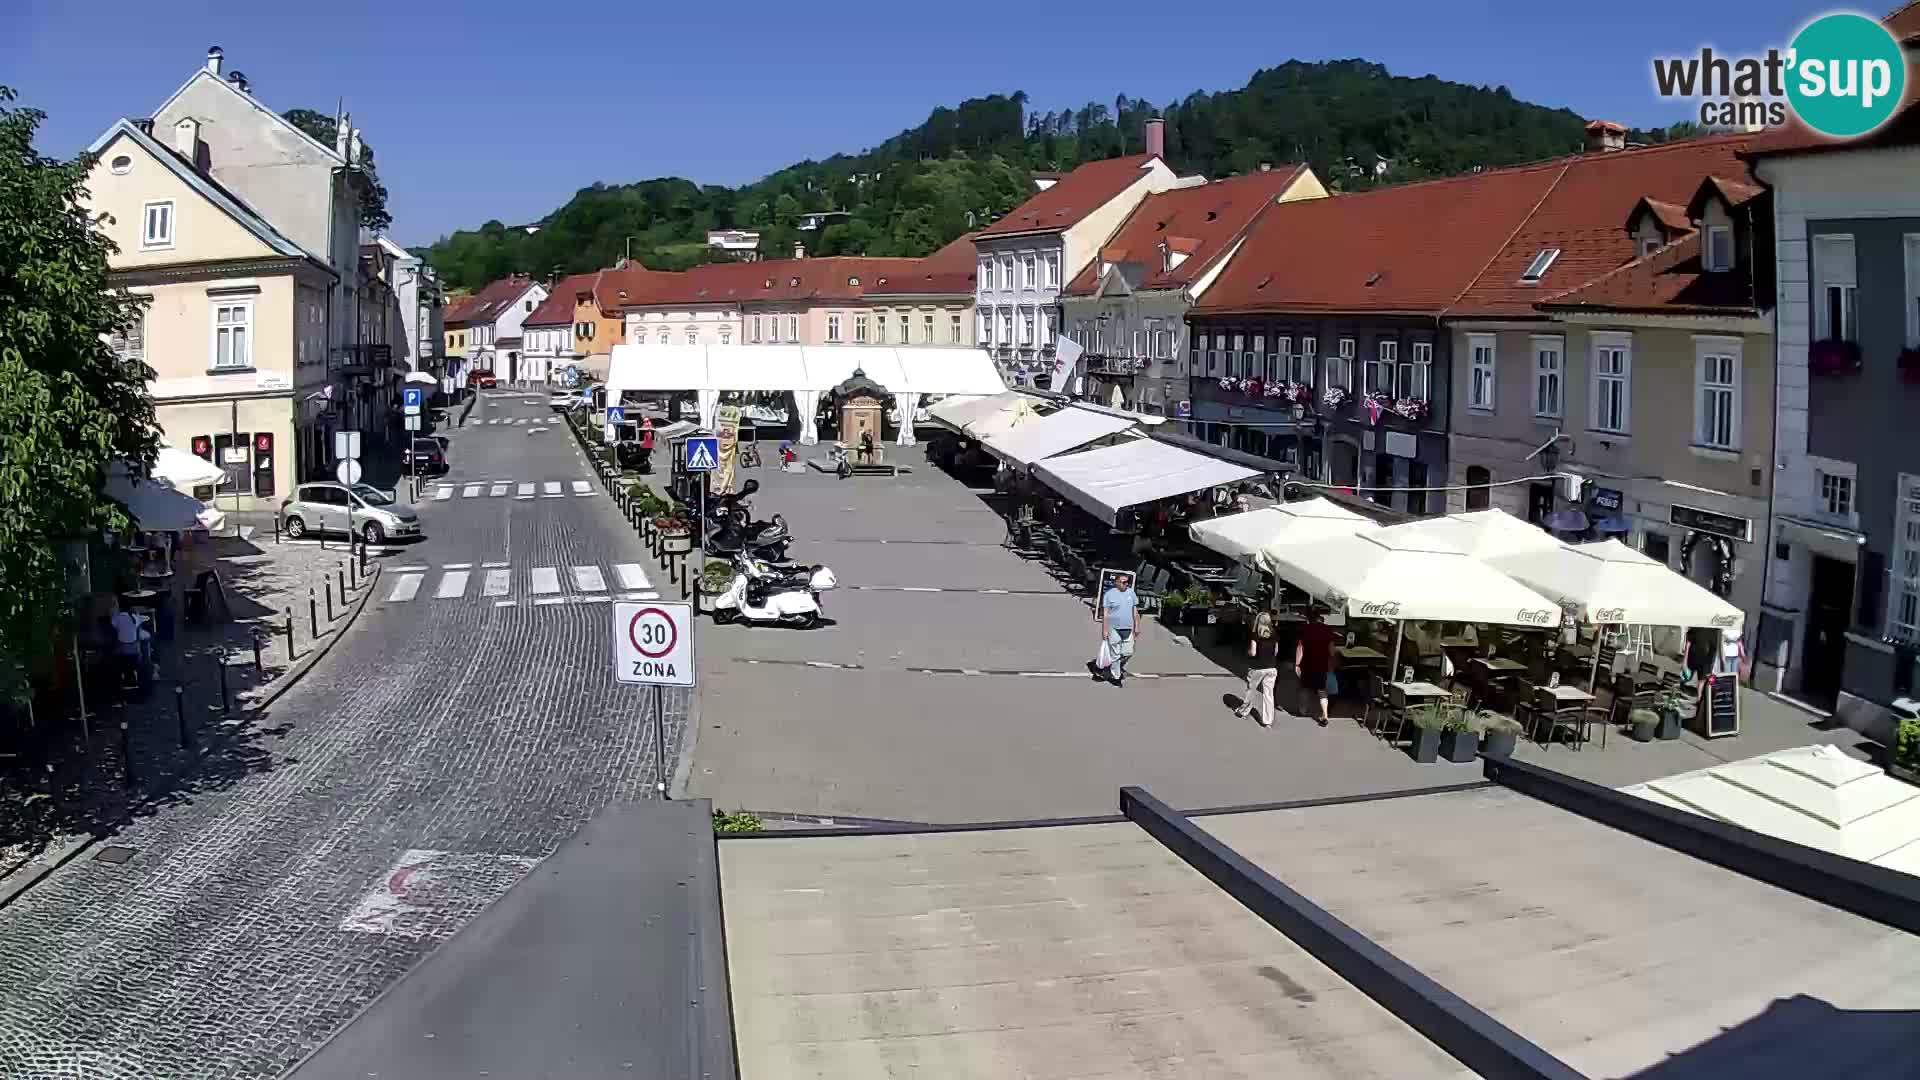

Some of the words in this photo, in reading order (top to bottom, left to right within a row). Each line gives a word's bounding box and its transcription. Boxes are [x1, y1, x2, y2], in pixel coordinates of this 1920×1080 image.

[408, 392, 416, 404] P
[642, 623, 666, 645] 30
[632, 660, 677, 678] ZONA
